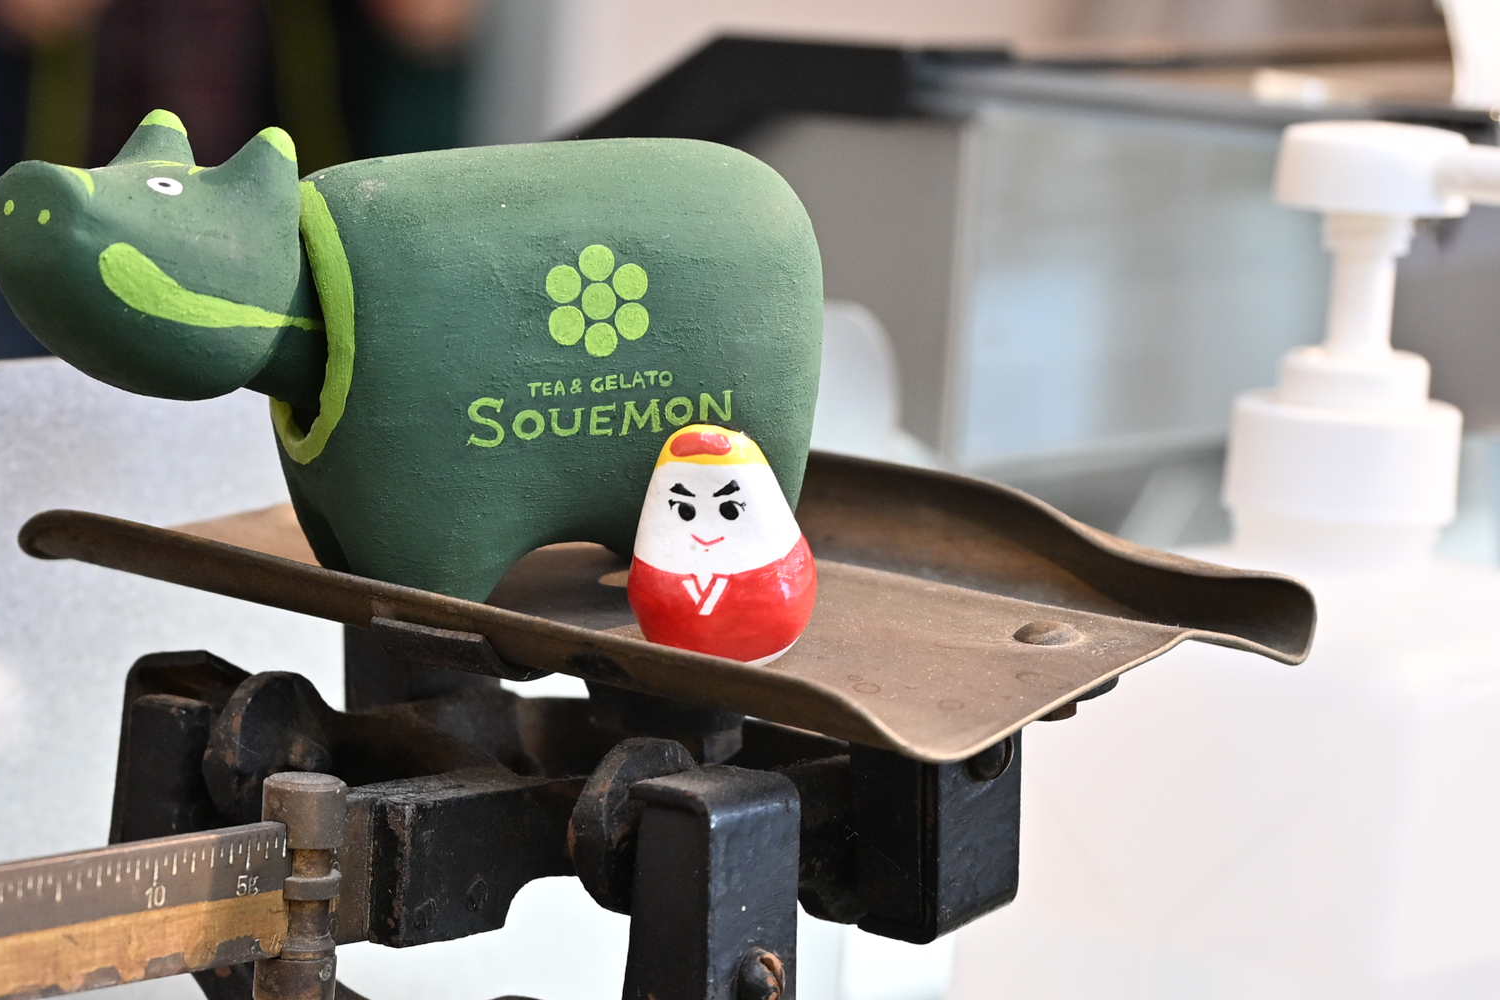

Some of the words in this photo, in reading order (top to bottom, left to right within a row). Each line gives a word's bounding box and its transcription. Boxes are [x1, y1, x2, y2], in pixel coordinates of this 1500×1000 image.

[527, 381, 566, 398] TEA
[589, 370, 674, 393] GELATO
[465, 390, 734, 448] SOUEMON
[145, 884, 167, 909] 10
